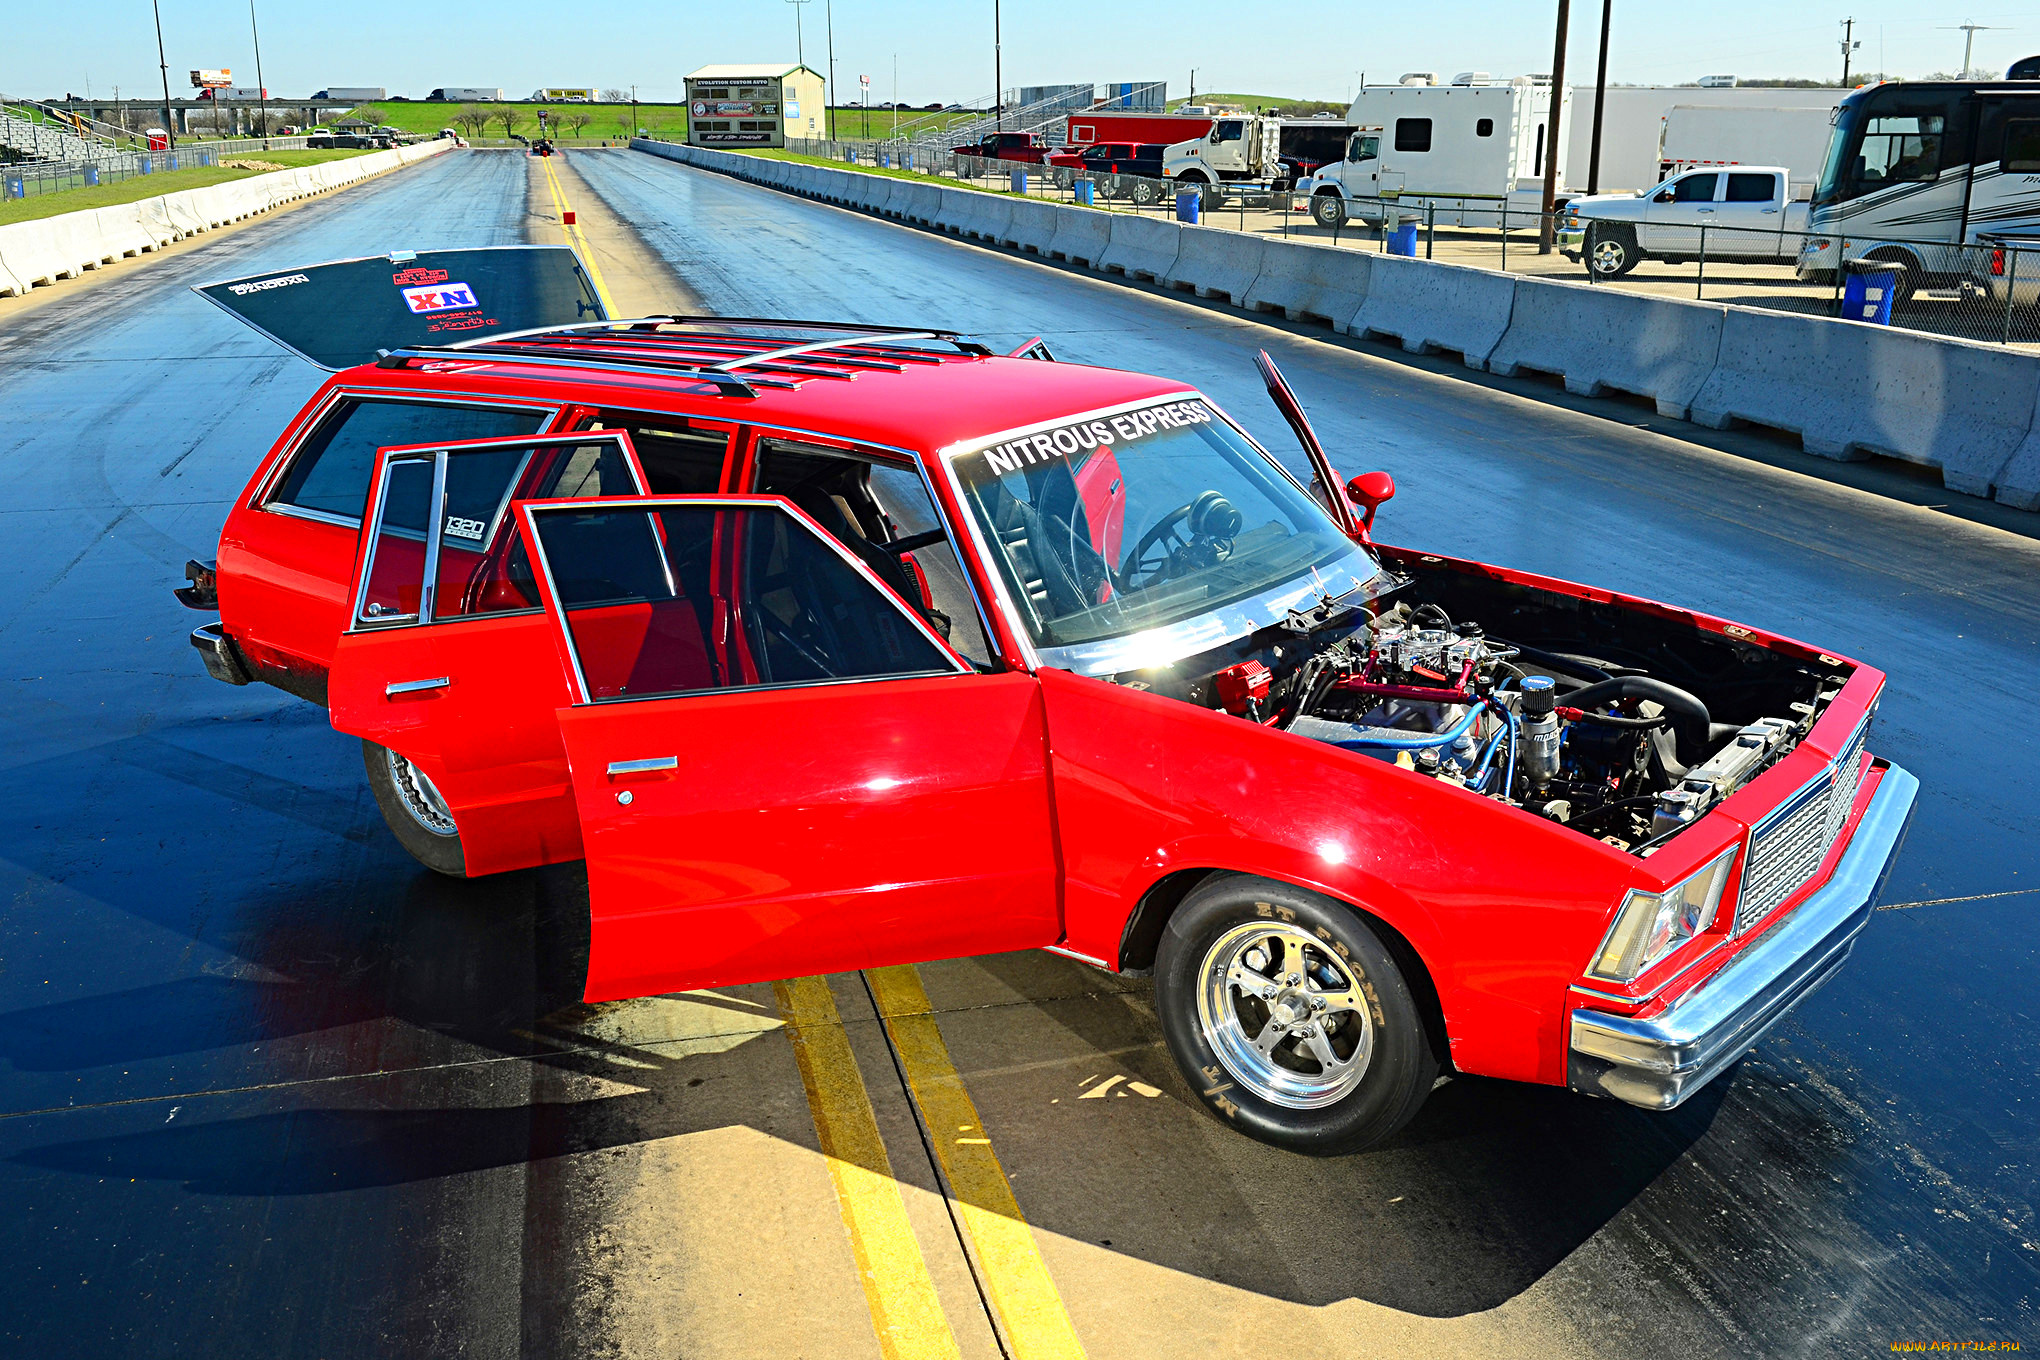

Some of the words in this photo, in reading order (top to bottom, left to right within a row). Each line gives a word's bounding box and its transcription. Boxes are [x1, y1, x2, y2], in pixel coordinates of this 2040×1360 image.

[409, 290, 473, 310] NX
[983, 421, 1115, 476] NITROUS
[1110, 401, 1211, 441] EXPRESS
[446, 516, 485, 534] 1320
[1255, 901, 1296, 921] ET
[1316, 926, 1385, 1027] FRONT
[1201, 1065, 1239, 1118] M/T
